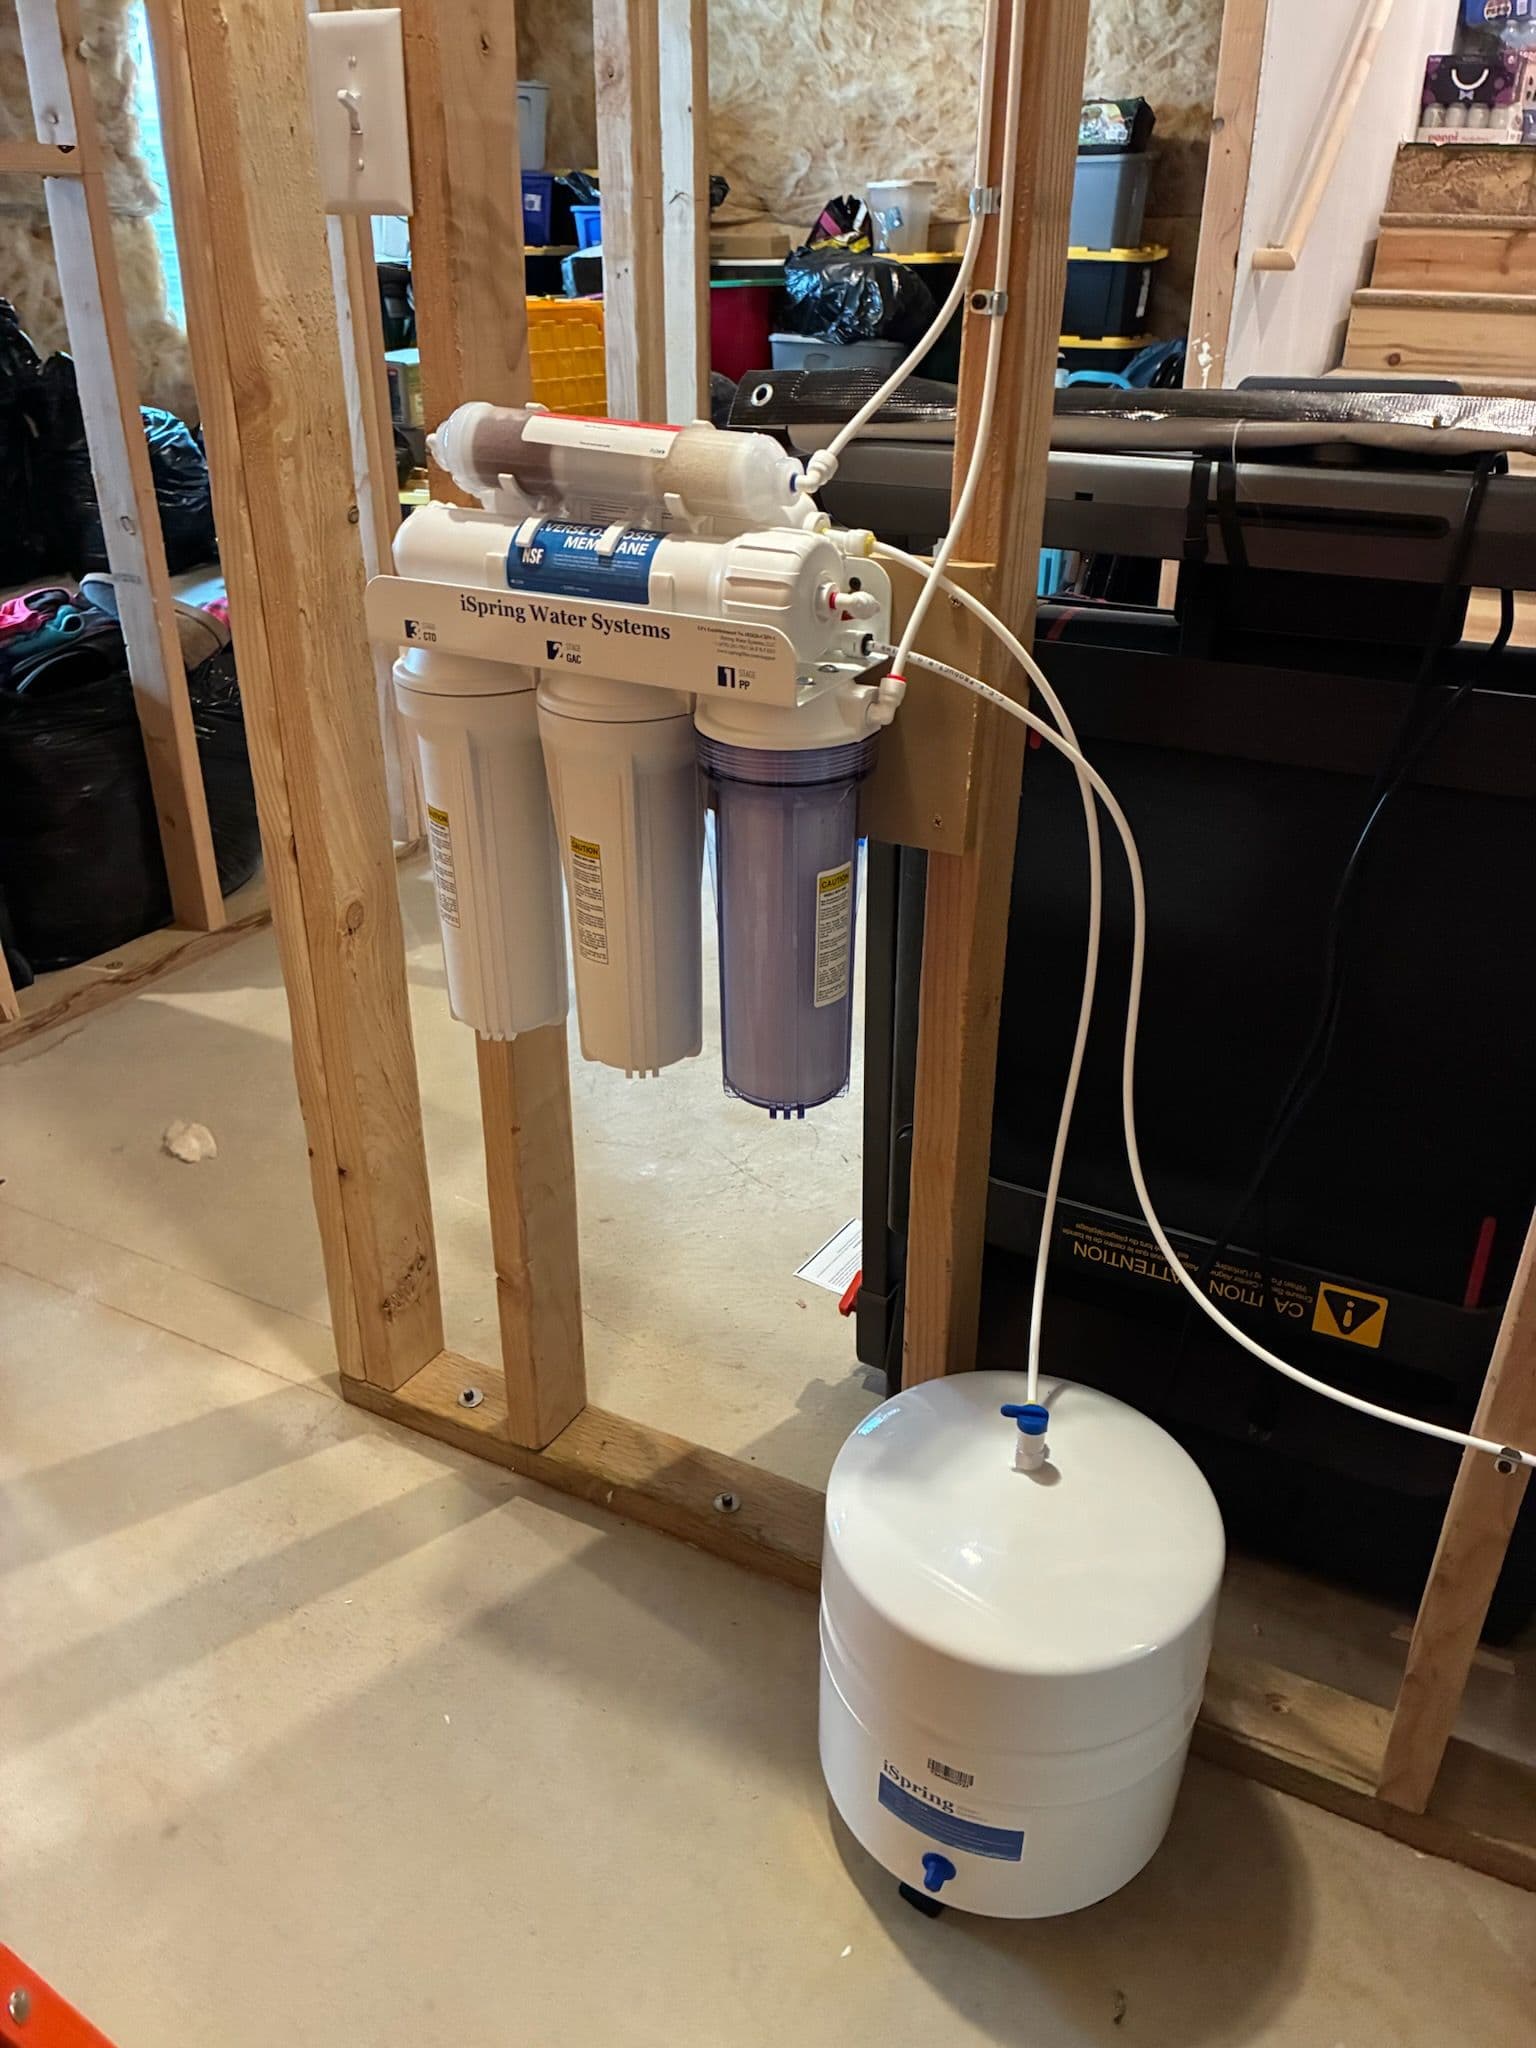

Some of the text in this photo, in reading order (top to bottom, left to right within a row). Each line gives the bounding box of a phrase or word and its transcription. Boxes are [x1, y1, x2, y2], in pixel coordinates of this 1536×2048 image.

[540, 523, 656, 542] VERSE OSOSIS
[563, 536, 649, 556] MEMANE
[522, 547, 544, 565] NSF
[460, 594, 671, 640] iSpring Water Systems
[423, 631, 437, 642] CTO
[566, 652, 582, 664] GAC
[739, 680, 750, 690] PP
[571, 840, 599, 856] CAUTION
[821, 873, 849, 889] CAUTION
[883, 1760, 954, 1814] iSpring
